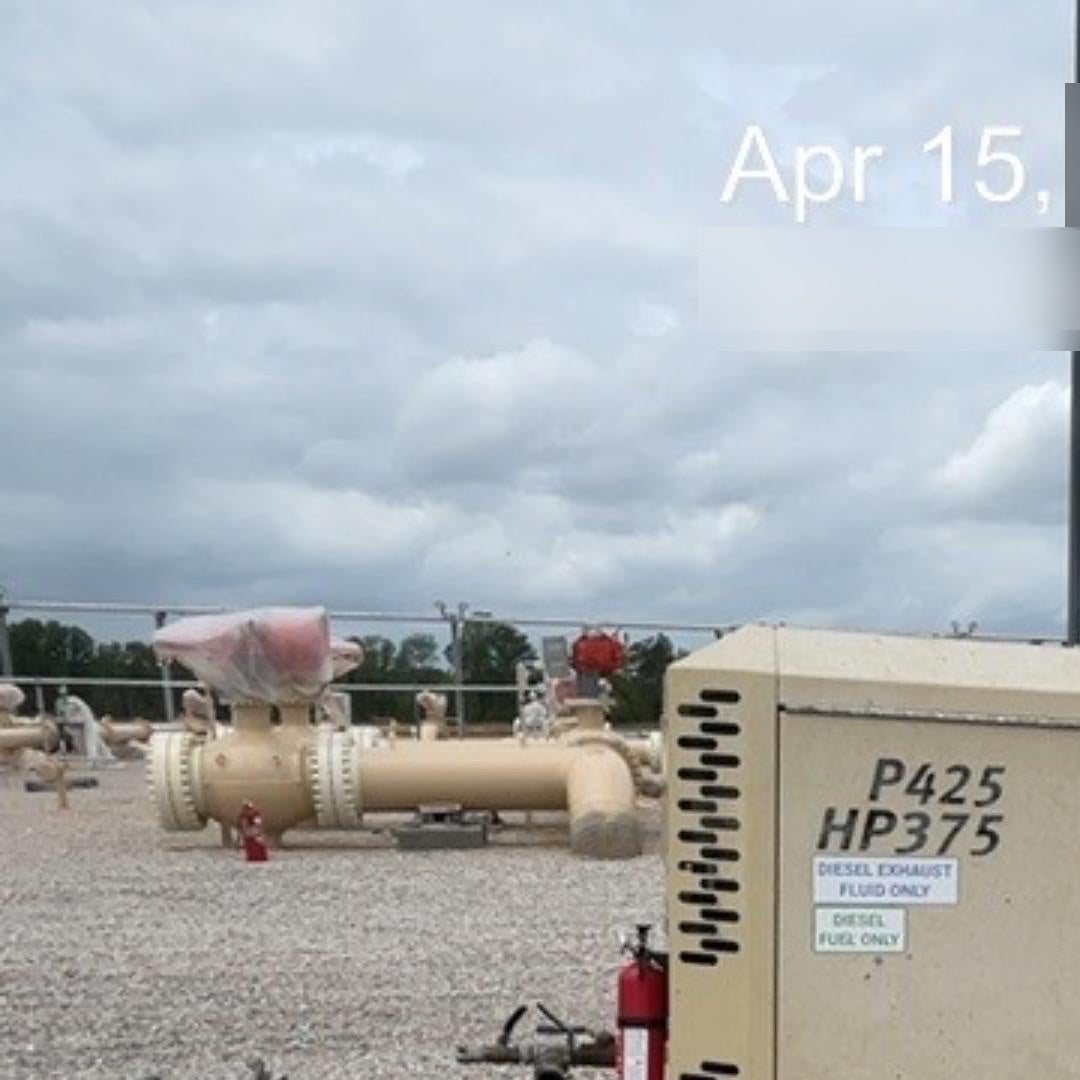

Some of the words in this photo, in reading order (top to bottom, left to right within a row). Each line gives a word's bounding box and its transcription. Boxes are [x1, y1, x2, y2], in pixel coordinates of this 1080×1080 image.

[869, 758, 1006, 807] P425
[817, 806, 1005, 856] HP375
[817, 862, 873, 877] DIESEL
[878, 863, 952, 877] EXHAUST
[839, 883, 885, 897] FLUID
[890, 883, 932, 897] ONLY
[832, 913, 884, 927] DIESEL
[818, 932, 857, 946] FUEL
[861, 932, 900, 947] ONLY
